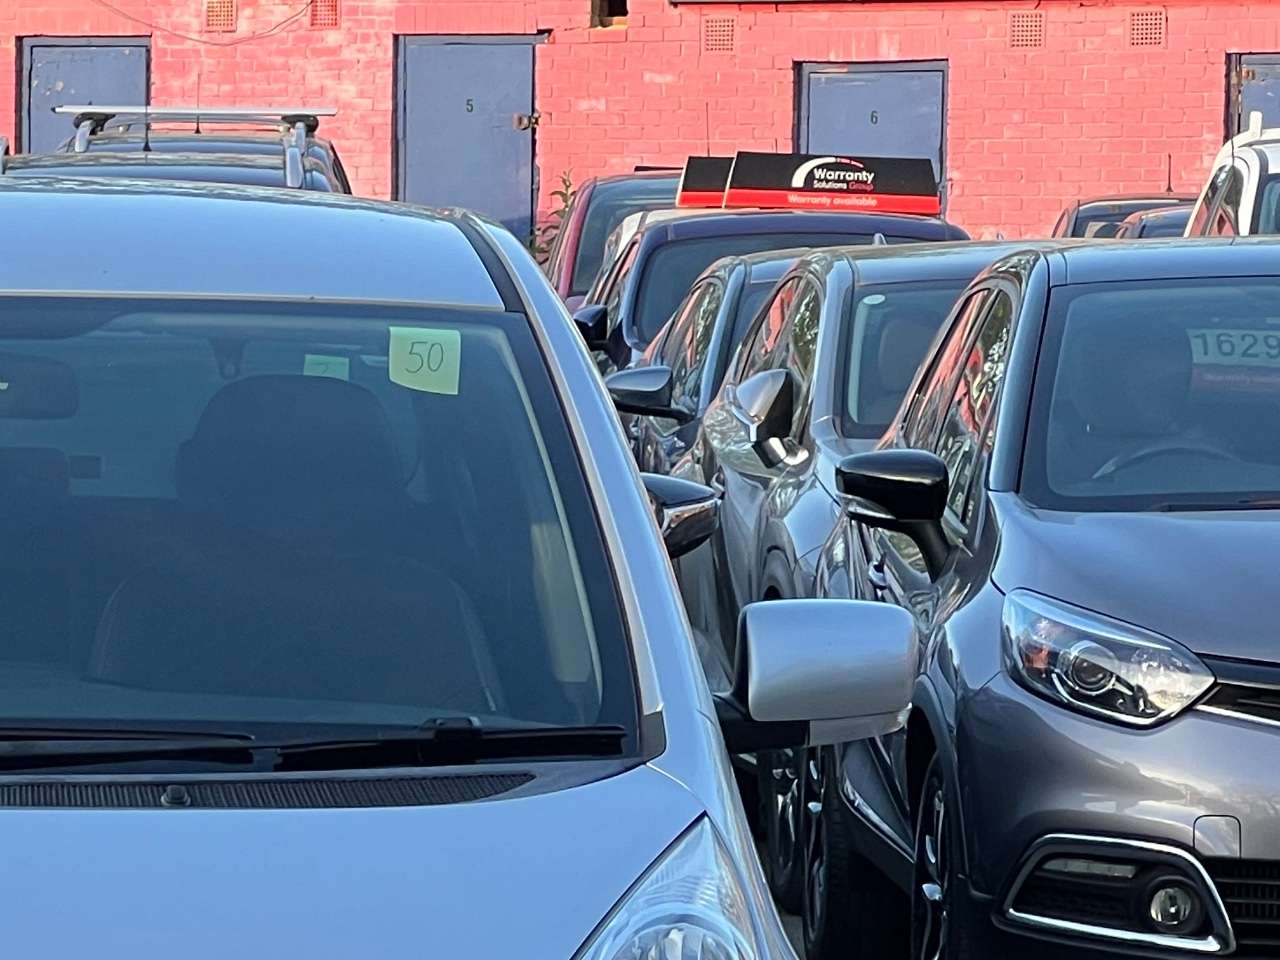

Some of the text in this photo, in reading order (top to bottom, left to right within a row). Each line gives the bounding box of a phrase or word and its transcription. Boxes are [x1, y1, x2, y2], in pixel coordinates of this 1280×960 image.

[466, 98, 474, 113] 5
[870, 110, 878, 125] 6
[813, 168, 874, 184] Warranty
[813, 180, 847, 190] Solutions
[787, 194, 877, 207] Warranty available
[1193, 333, 1280, 359] 1629
[406, 341, 444, 374] 50
